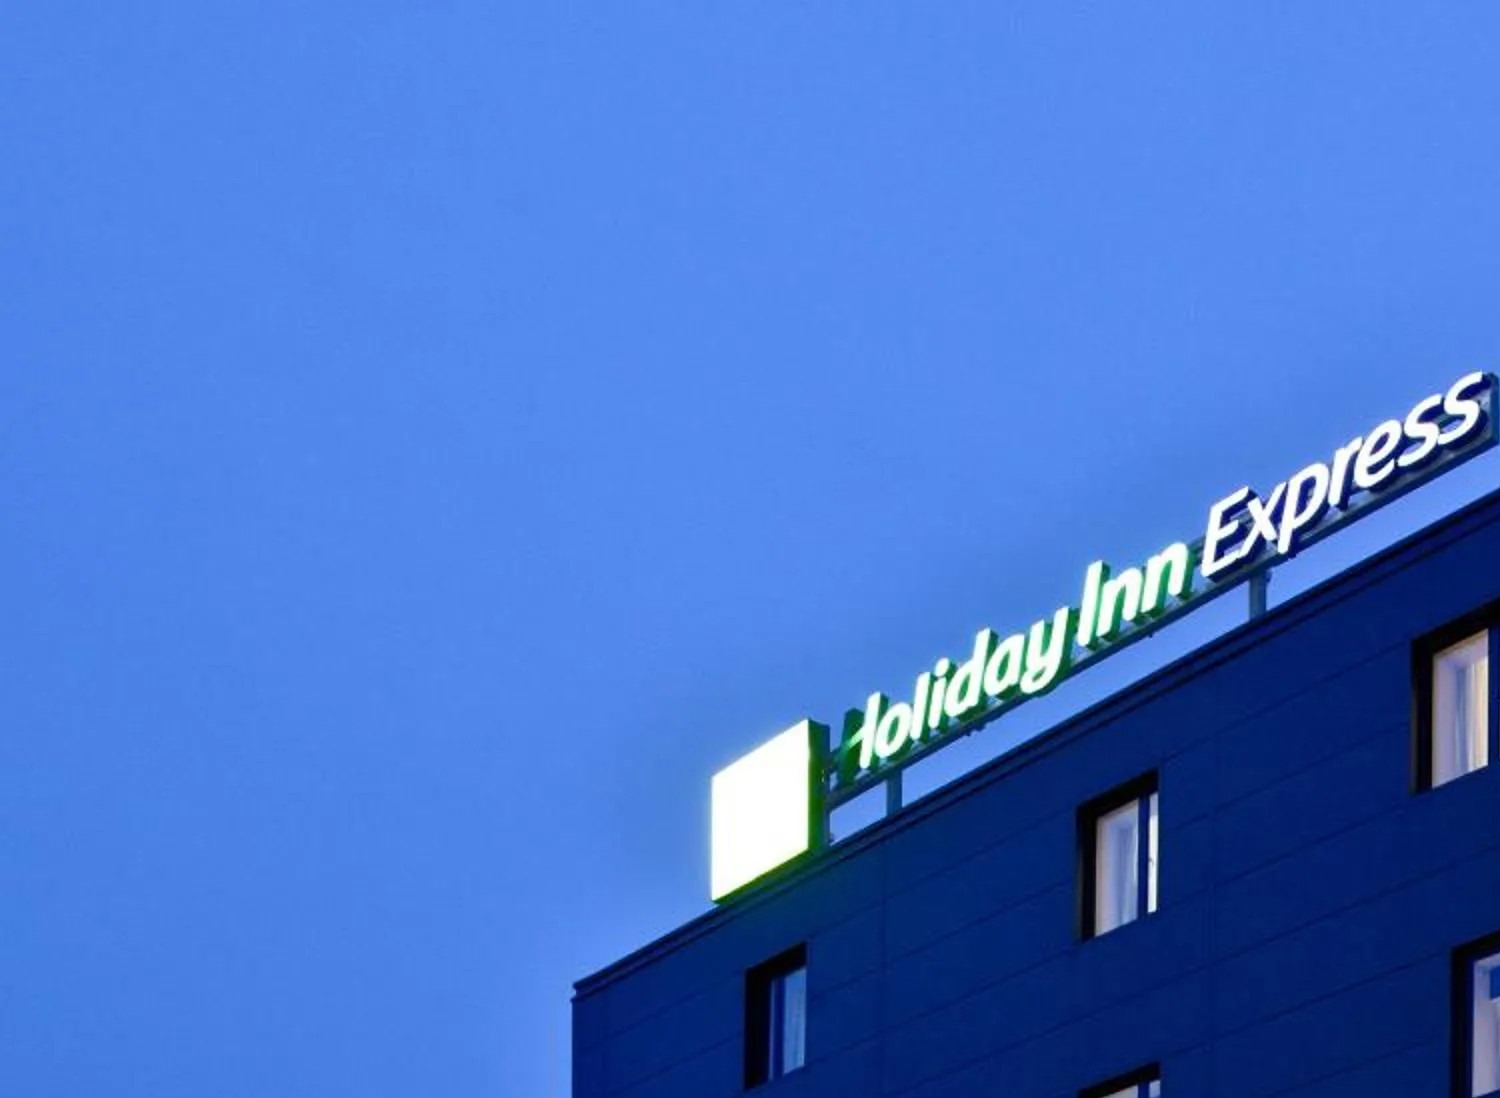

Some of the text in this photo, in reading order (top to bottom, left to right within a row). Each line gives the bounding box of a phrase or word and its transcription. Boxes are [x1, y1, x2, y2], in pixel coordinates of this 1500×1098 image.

[841, 371, 1485, 770] Holiday Inn Express
